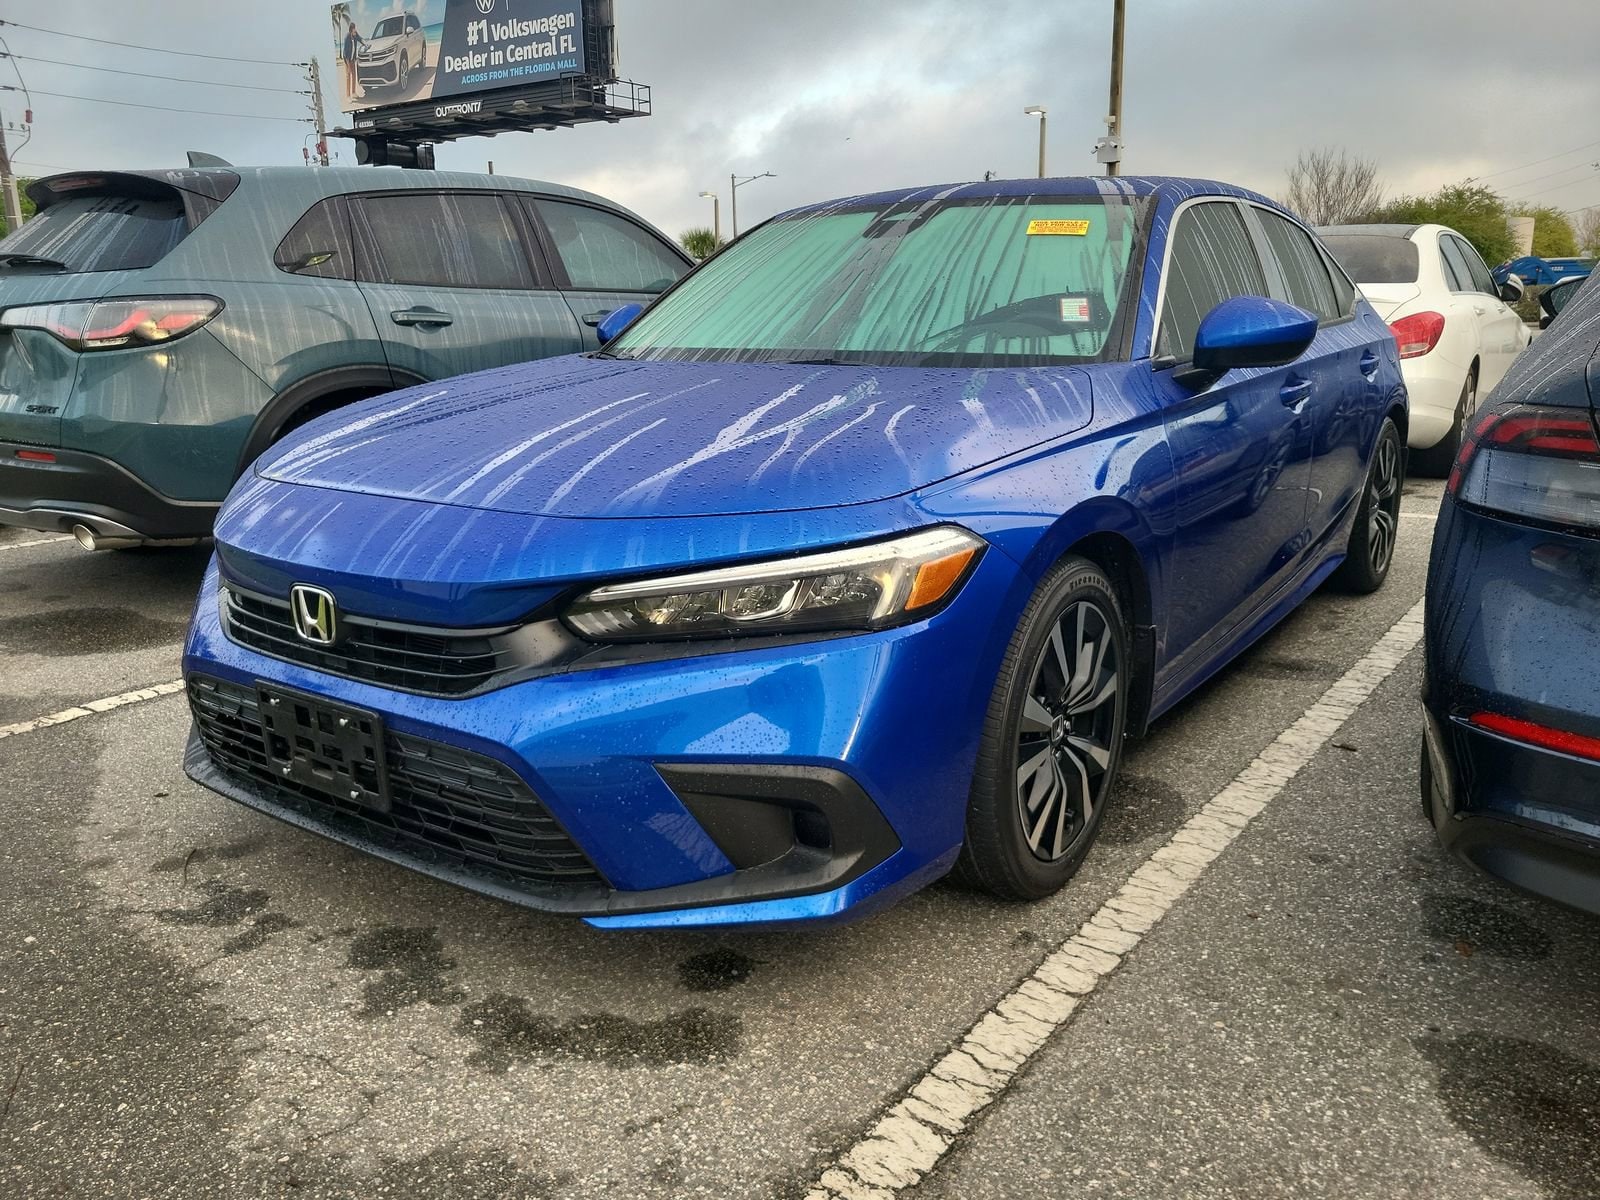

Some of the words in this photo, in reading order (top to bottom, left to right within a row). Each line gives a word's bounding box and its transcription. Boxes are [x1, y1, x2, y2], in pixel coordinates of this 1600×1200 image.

[467, 19, 489, 46] #1
[490, 12, 575, 42] Volkswagen
[444, 50, 488, 73] Dealer
[490, 45, 504, 66] in
[506, 36, 557, 63] Central
[560, 34, 577, 54] FL
[461, 72, 488, 85] ACROSS
[489, 69, 509, 80] FROM
[510, 67, 524, 78] THE
[525, 62, 556, 77] FLORIDA
[557, 58, 577, 72] MALL
[25, 404, 60, 414] SPORT
